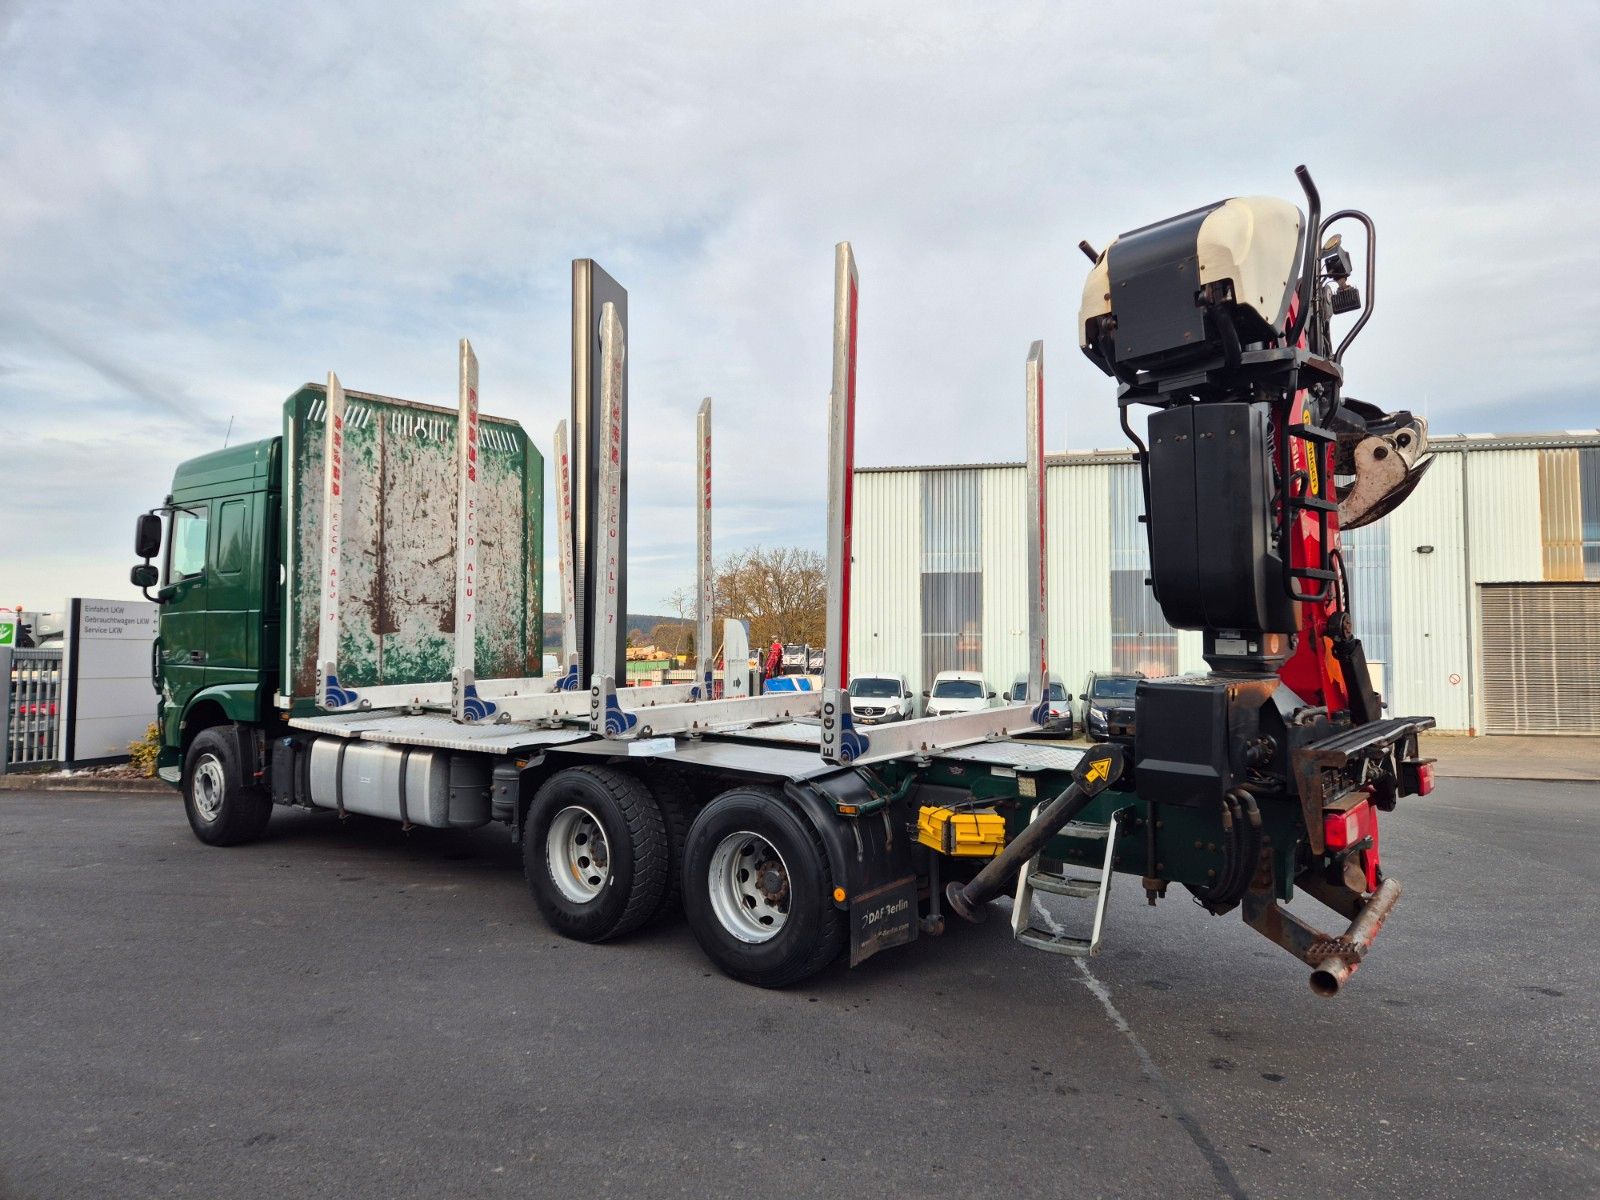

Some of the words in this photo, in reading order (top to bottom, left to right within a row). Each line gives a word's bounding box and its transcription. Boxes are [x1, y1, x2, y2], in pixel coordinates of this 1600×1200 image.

[466, 563, 474, 597] ALU
[84, 605, 109, 613] Einfahrt
[84, 615, 135, 626] Gebrauchtwagen
[136, 617, 150, 625] LKW
[329, 613, 335, 621] 7
[466, 614, 472, 622] 7
[608, 614, 614, 624] 7
[84, 626, 107, 634] Service
[868, 906, 885, 925] DAF
